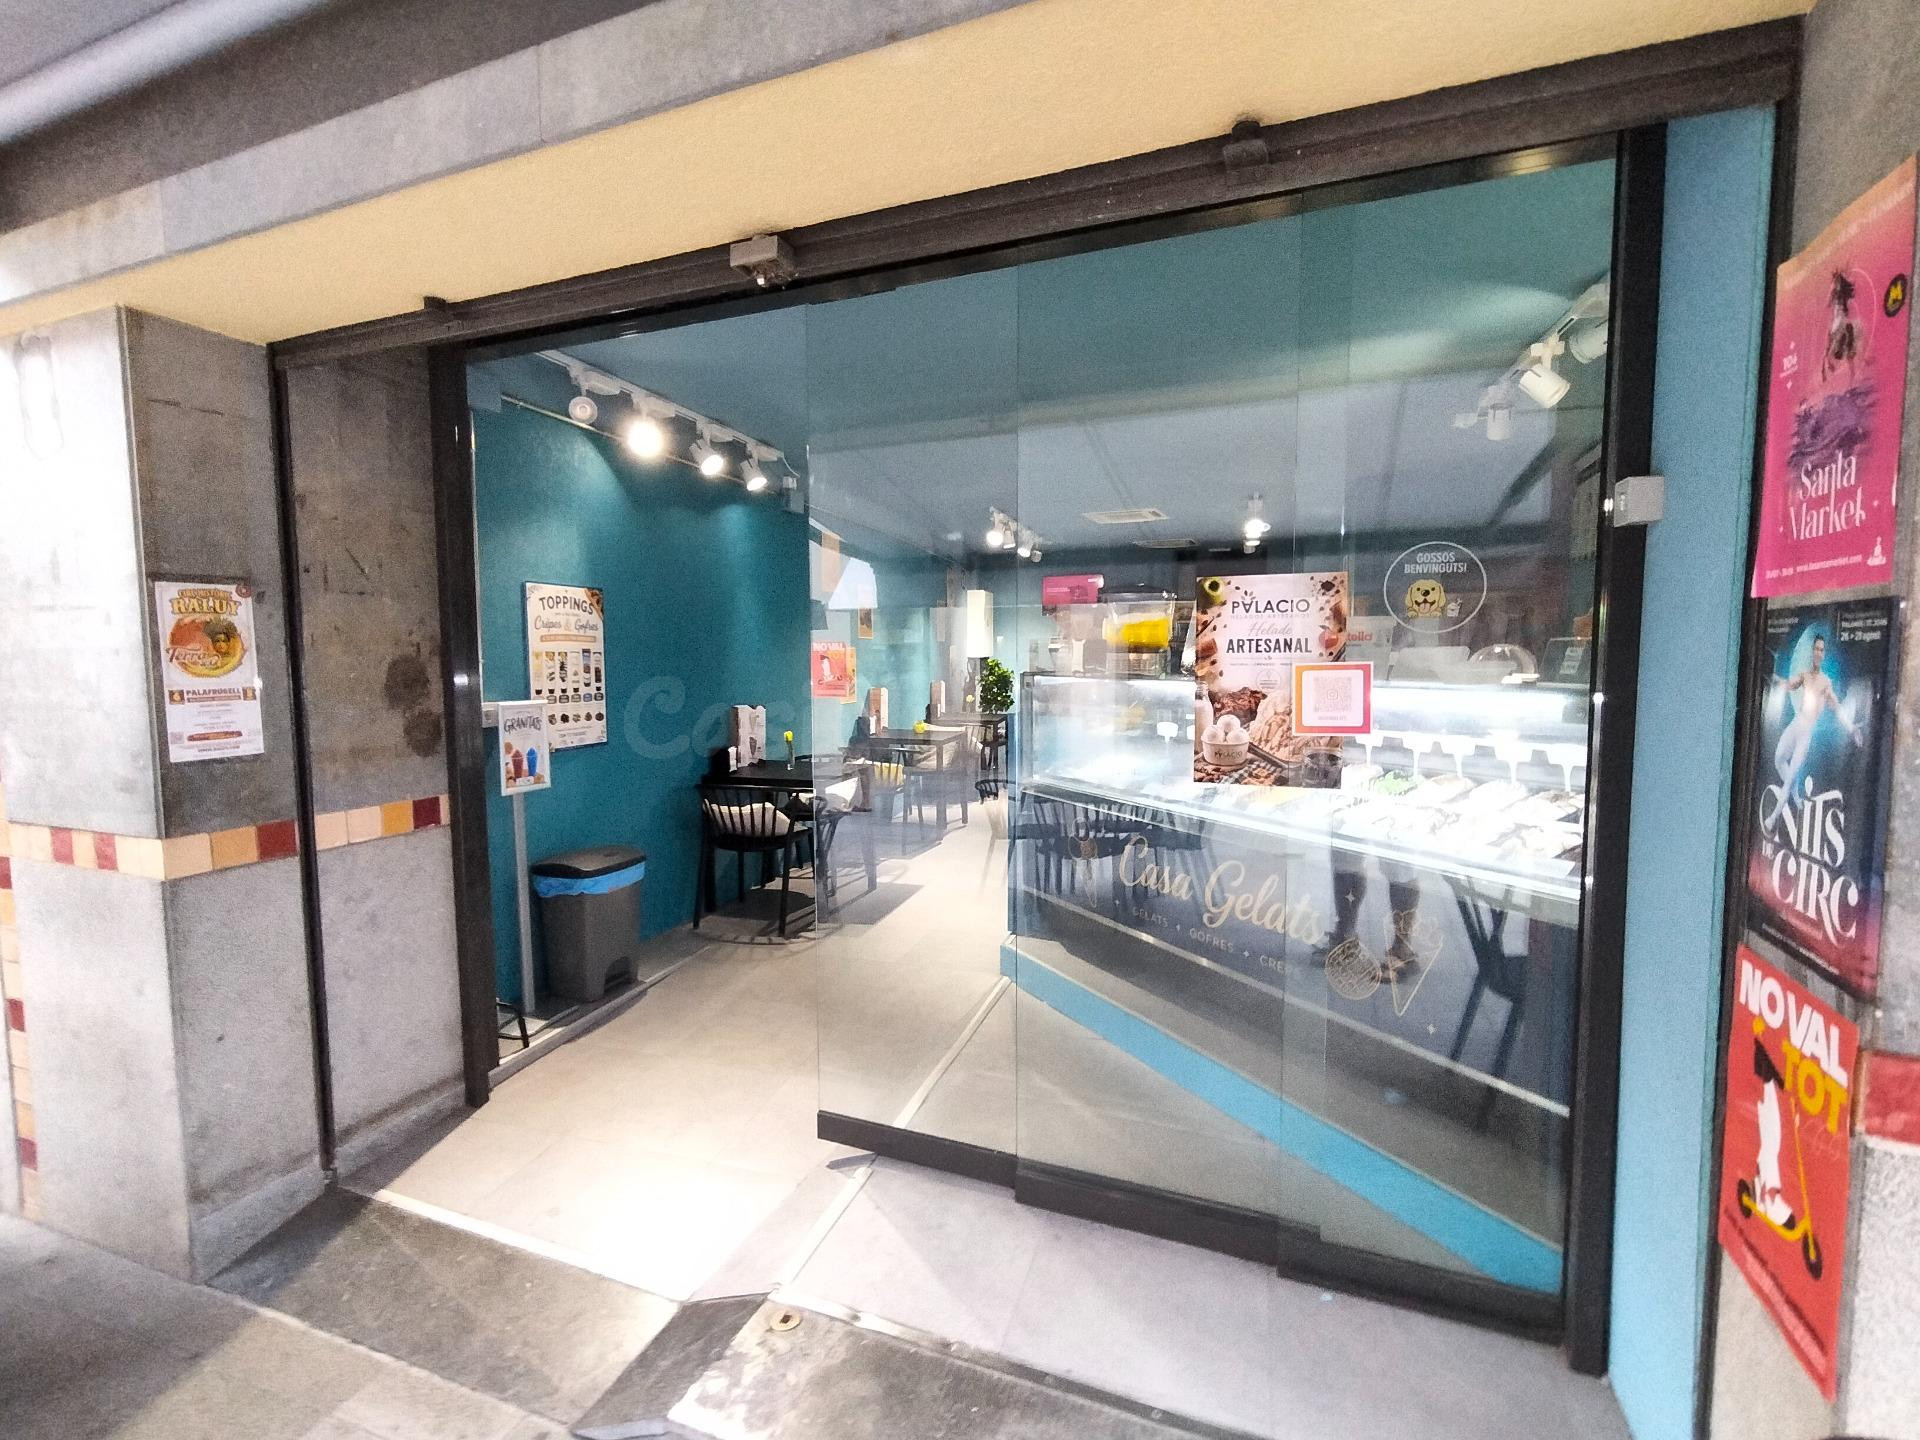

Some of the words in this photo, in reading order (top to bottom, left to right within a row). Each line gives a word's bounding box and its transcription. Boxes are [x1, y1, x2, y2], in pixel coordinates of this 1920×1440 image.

[1800, 450, 1857, 500] Santa
[1790, 485, 1866, 541] Market
[1416, 552, 1456, 563] GOSSOS
[1404, 562, 1467, 574] BENVINGUTS!
[169, 597, 242, 616] RALUY
[539, 595, 594, 615] TOPPINGS
[1231, 599, 1310, 614] PALACIO
[574, 618, 600, 634] Gofres
[1248, 621, 1294, 636] Helado
[1226, 637, 1312, 654] ARTESANAL
[1119, 835, 1194, 900] Casa
[1203, 860, 1326, 946] Gelats
[1772, 849, 1859, 948] CIRC
[1132, 906, 1169, 928] GELATS
[1189, 927, 1234, 951] GOFRES
[1739, 959, 1785, 1030] NO
[1787, 990, 1849, 1089] VAL
[1782, 1039, 1848, 1136] TOT
